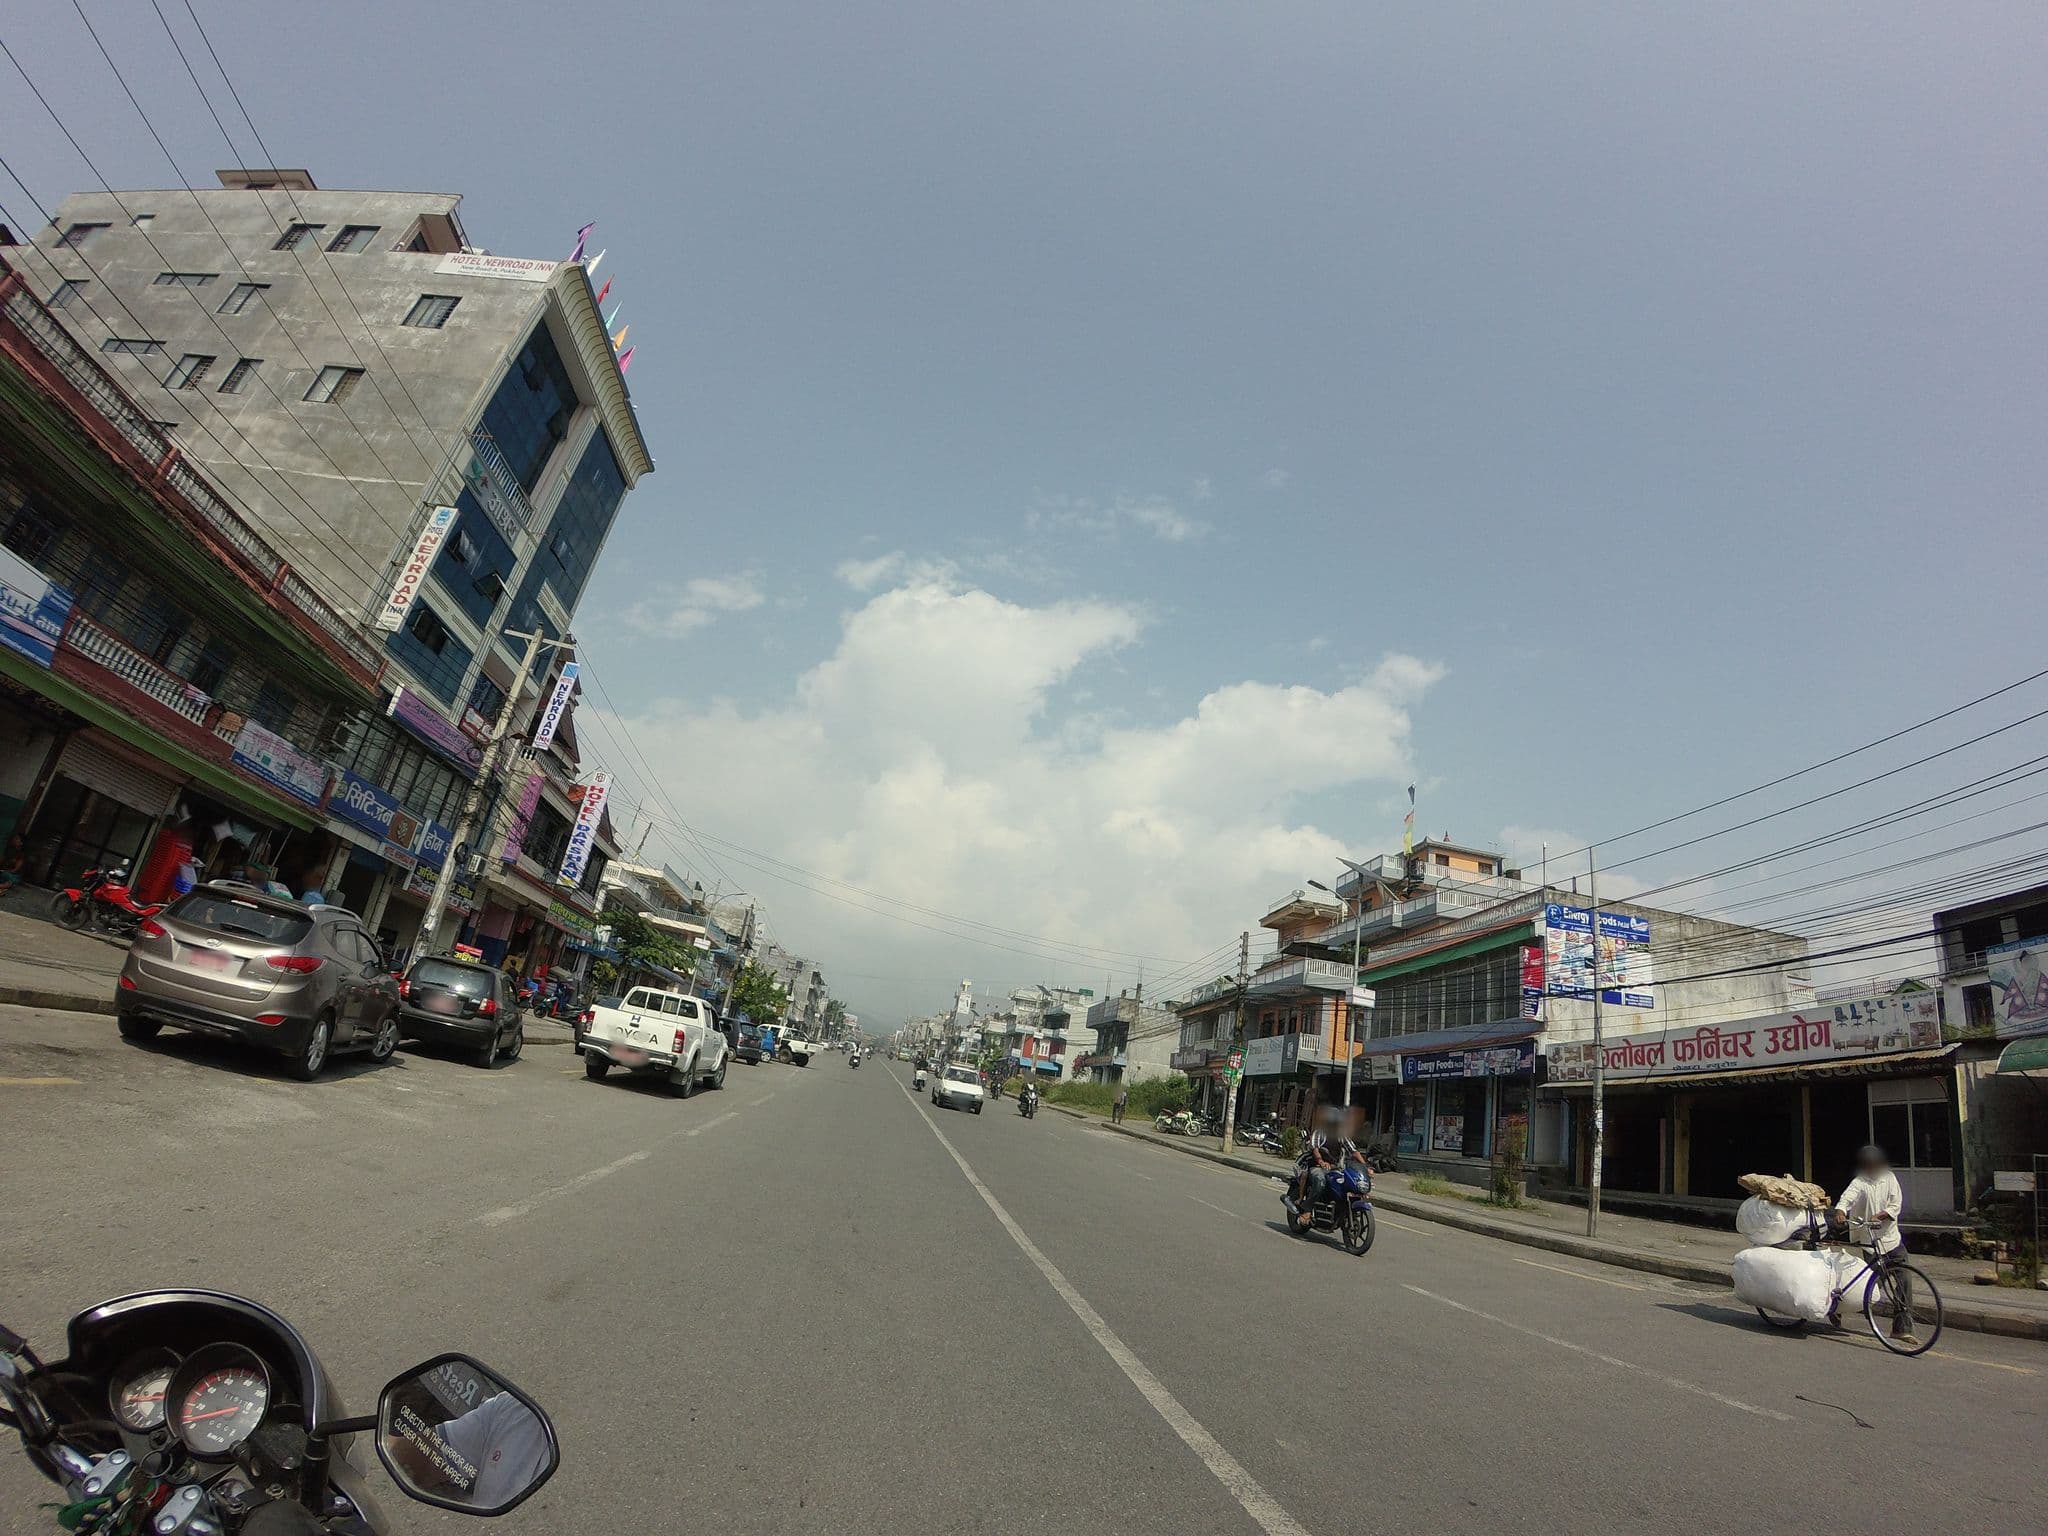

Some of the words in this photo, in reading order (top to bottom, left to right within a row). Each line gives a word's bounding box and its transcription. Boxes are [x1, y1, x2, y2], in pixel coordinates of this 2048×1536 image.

[450, 255, 481, 266] HOTEL
[483, 257, 534, 270] NEWROAD
[534, 262, 554, 272] INN
[393, 535, 439, 605] NEWROAD
[386, 605, 406, 615] INN
[540, 684, 569, 737] NEWROAD
[535, 735, 550, 745] INN
[345, 781, 395, 827] सिटिजन
[580, 785, 605, 822] HOTEL
[561, 824, 591, 880] DARSHAN
[1563, 907, 1590, 924] Energy
[1673, 1027, 1756, 1063] फर्निचर
[1763, 1014, 1832, 1055] उद्योग
[1417, 1060, 1436, 1073] Energy
[1436, 1058, 1454, 1070] Foods
[394, 1418, 418, 1444] CLOSER
[414, 1437, 431, 1457] THAN
[428, 1451, 446, 1470] THEY
[443, 1463, 470, 1491] APPEAR
[400, 1405, 426, 1432] OBJECTS
[423, 1427, 432, 1438] IN
[429, 1431, 443, 1449] THE
[441, 1441, 465, 1470] MIRROR
[463, 1463, 478, 1479] ARE
